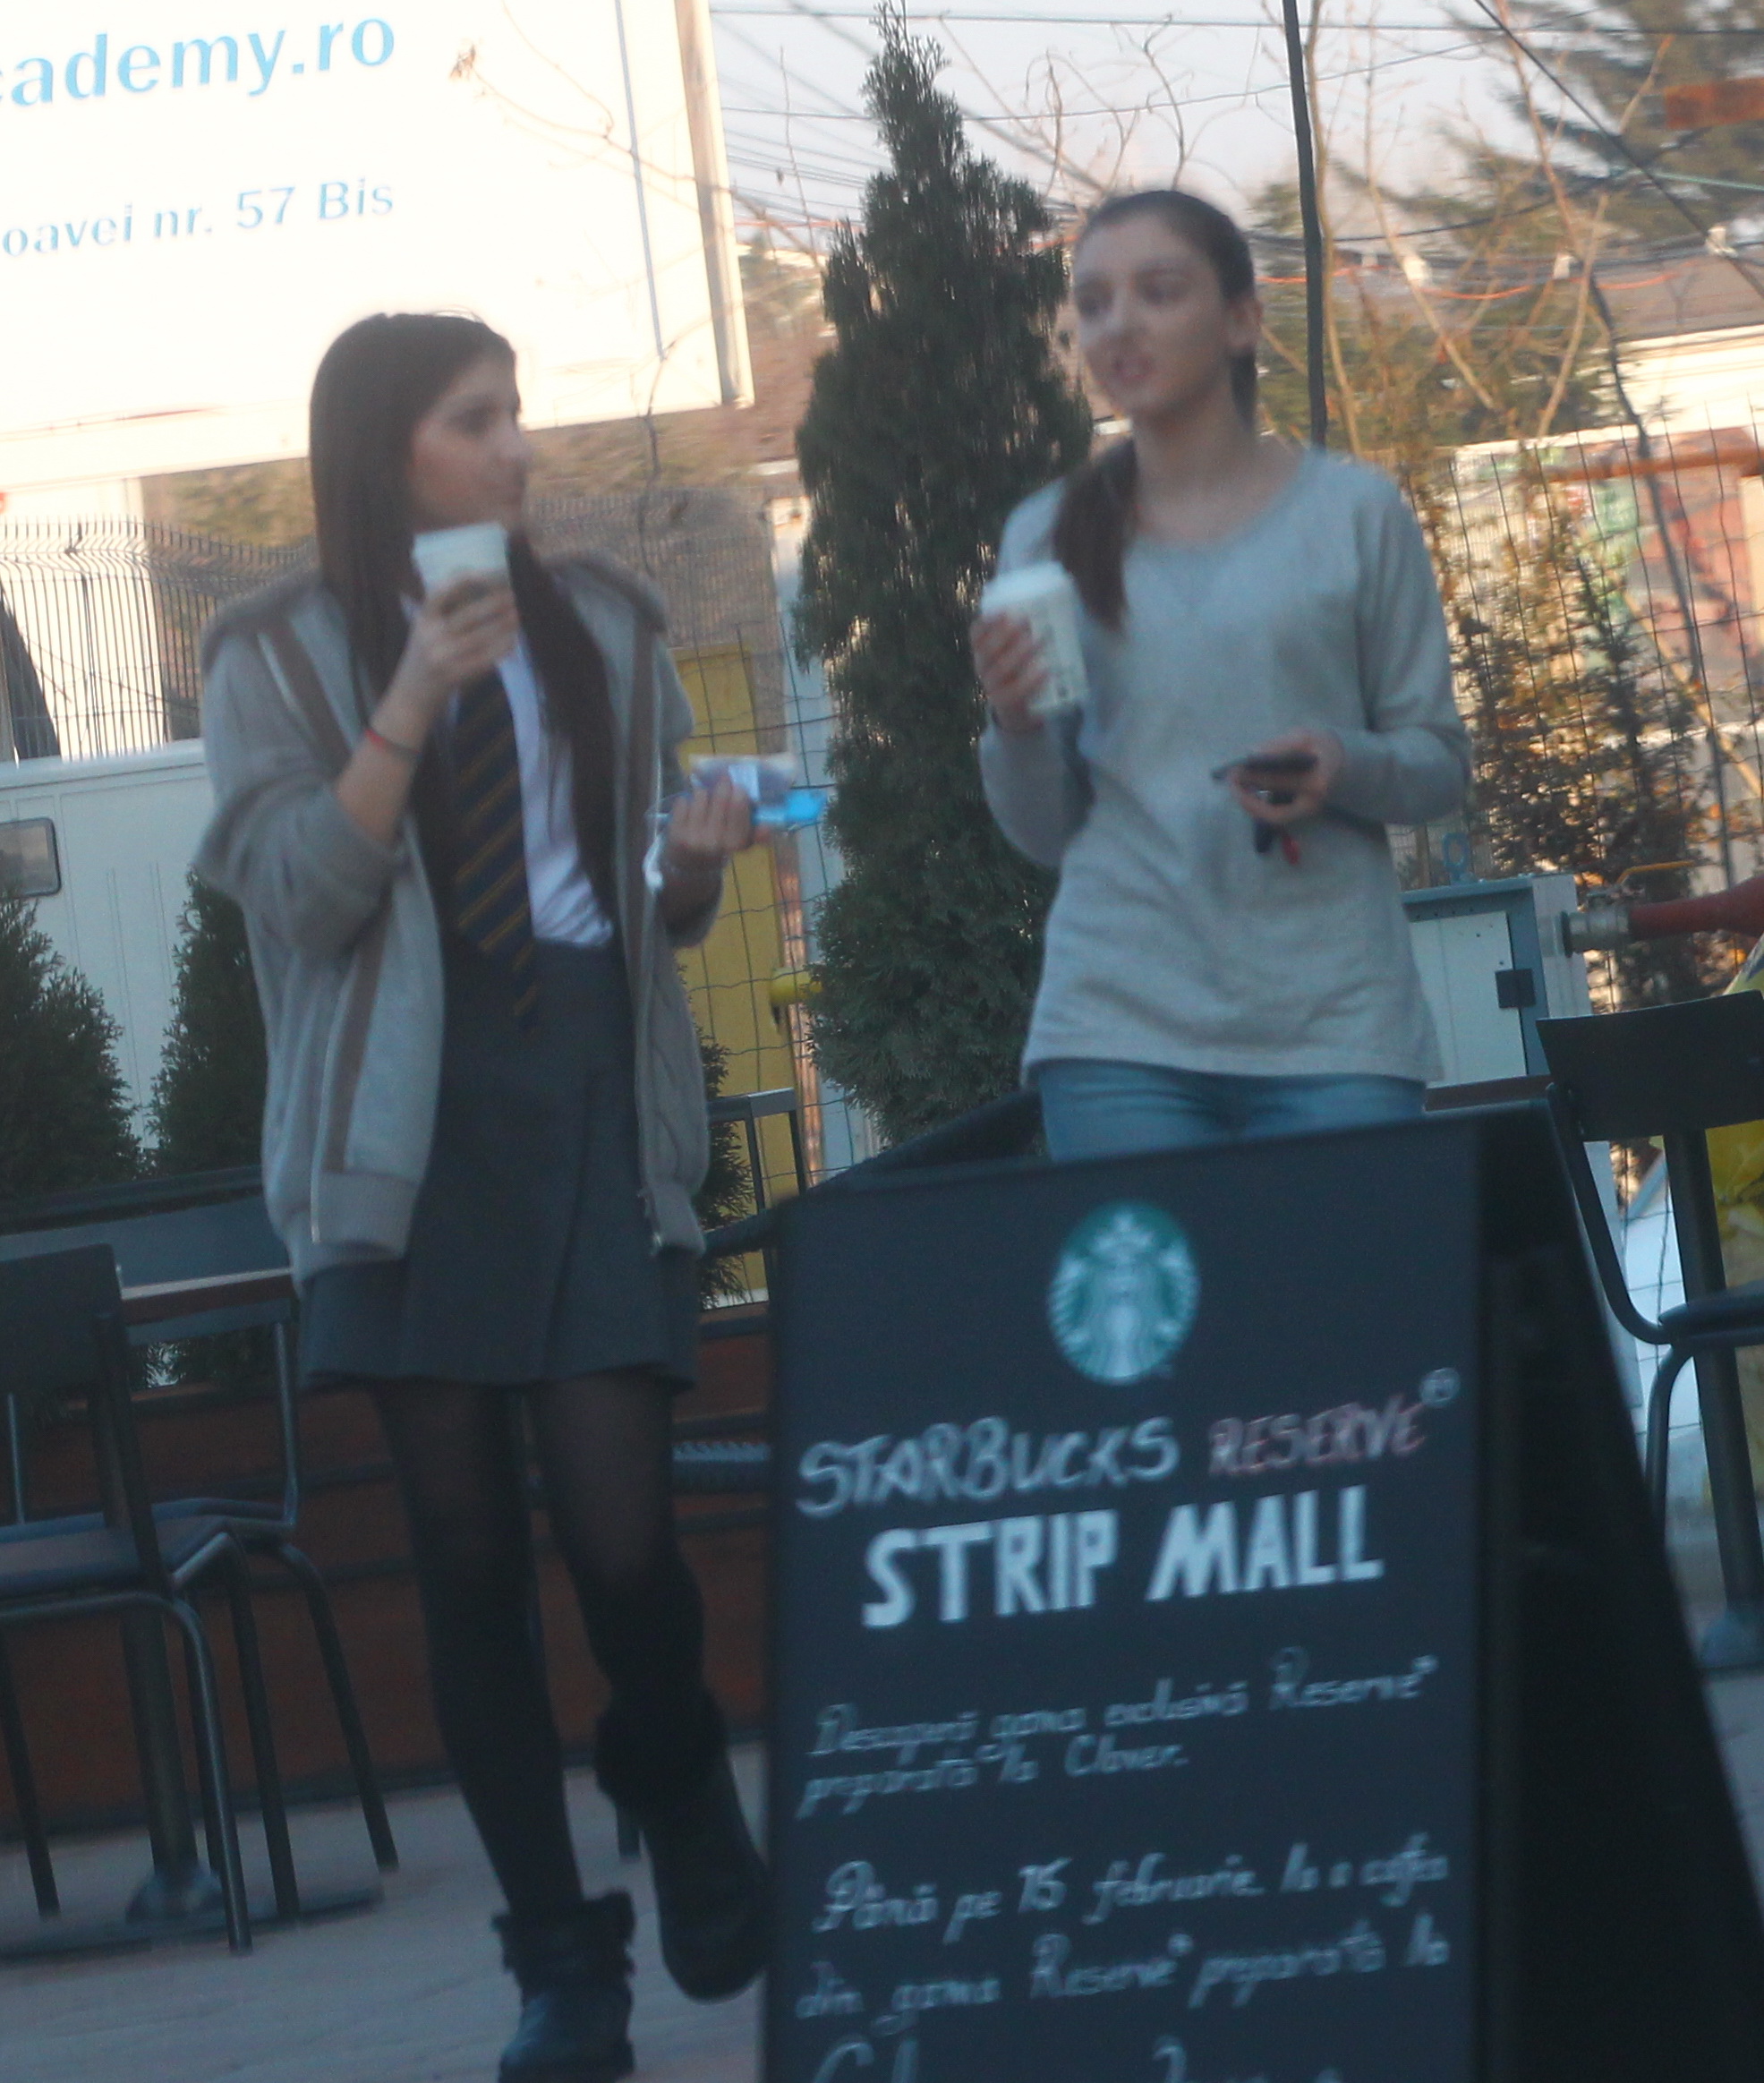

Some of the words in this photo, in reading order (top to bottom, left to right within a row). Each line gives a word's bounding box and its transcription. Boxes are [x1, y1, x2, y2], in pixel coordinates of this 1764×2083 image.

[0, 16, 396, 107] ademy.ro
[154, 204, 214, 239] nr.
[236, 186, 297, 230] 57
[319, 176, 395, 222] Bis
[796, 1415, 1181, 1519] STARBUCKS
[862, 1508, 1119, 1627] STRIP
[1146, 1484, 1385, 1601] MALL
[942, 1890, 1002, 1945] pe
[1280, 1842, 1320, 1894] la
[1407, 1912, 1452, 1968] la
